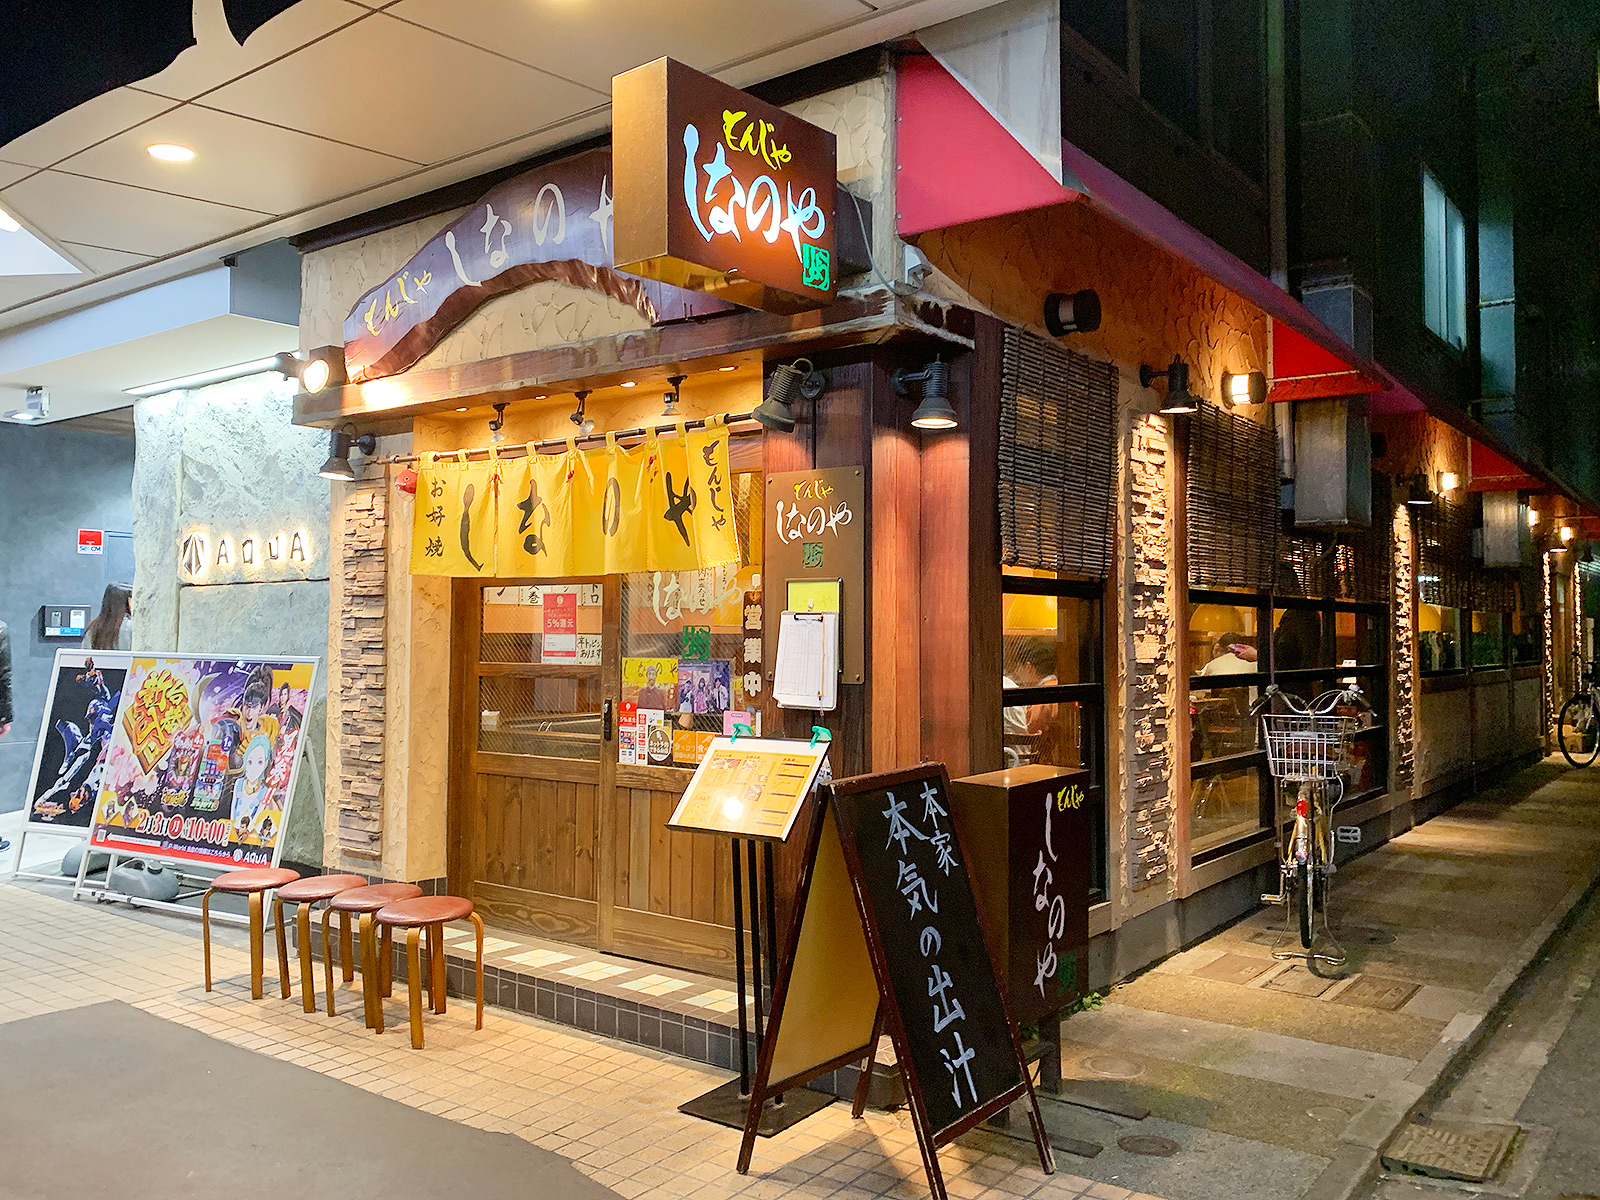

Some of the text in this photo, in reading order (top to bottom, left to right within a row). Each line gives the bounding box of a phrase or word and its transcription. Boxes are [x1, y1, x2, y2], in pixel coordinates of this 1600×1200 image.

[683, 123, 825, 263] しなのや
[216, 530, 306, 566] AQUA
[424, 477, 446, 558] お好焼
[459, 471, 697, 571] しなのや
[776, 500, 852, 545] しなのや
[743, 604, 762, 697] 営業中
[243, 851, 268, 866] AQUA
[921, 781, 959, 876] 本家
[1033, 792, 1065, 999] しなのや
[882, 790, 978, 1109] 本気の出汁
